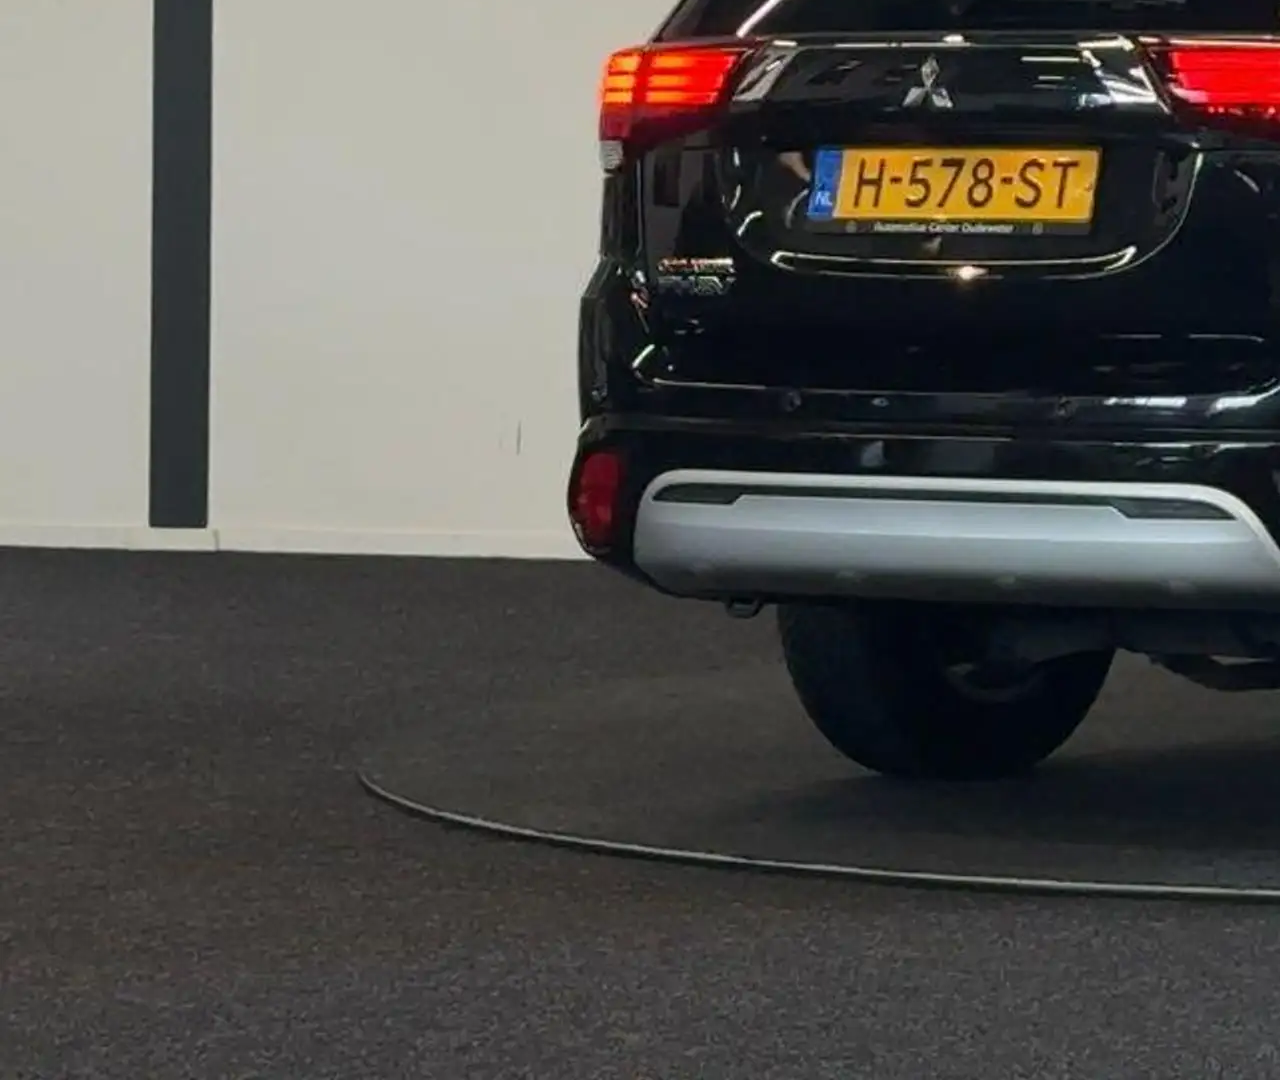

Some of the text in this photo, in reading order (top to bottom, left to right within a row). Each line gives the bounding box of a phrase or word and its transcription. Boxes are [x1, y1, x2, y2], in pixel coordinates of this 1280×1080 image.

[853, 158, 1080, 208] H-578-ST
[814, 190, 833, 207] NL
[873, 222, 926, 233] Automotive
